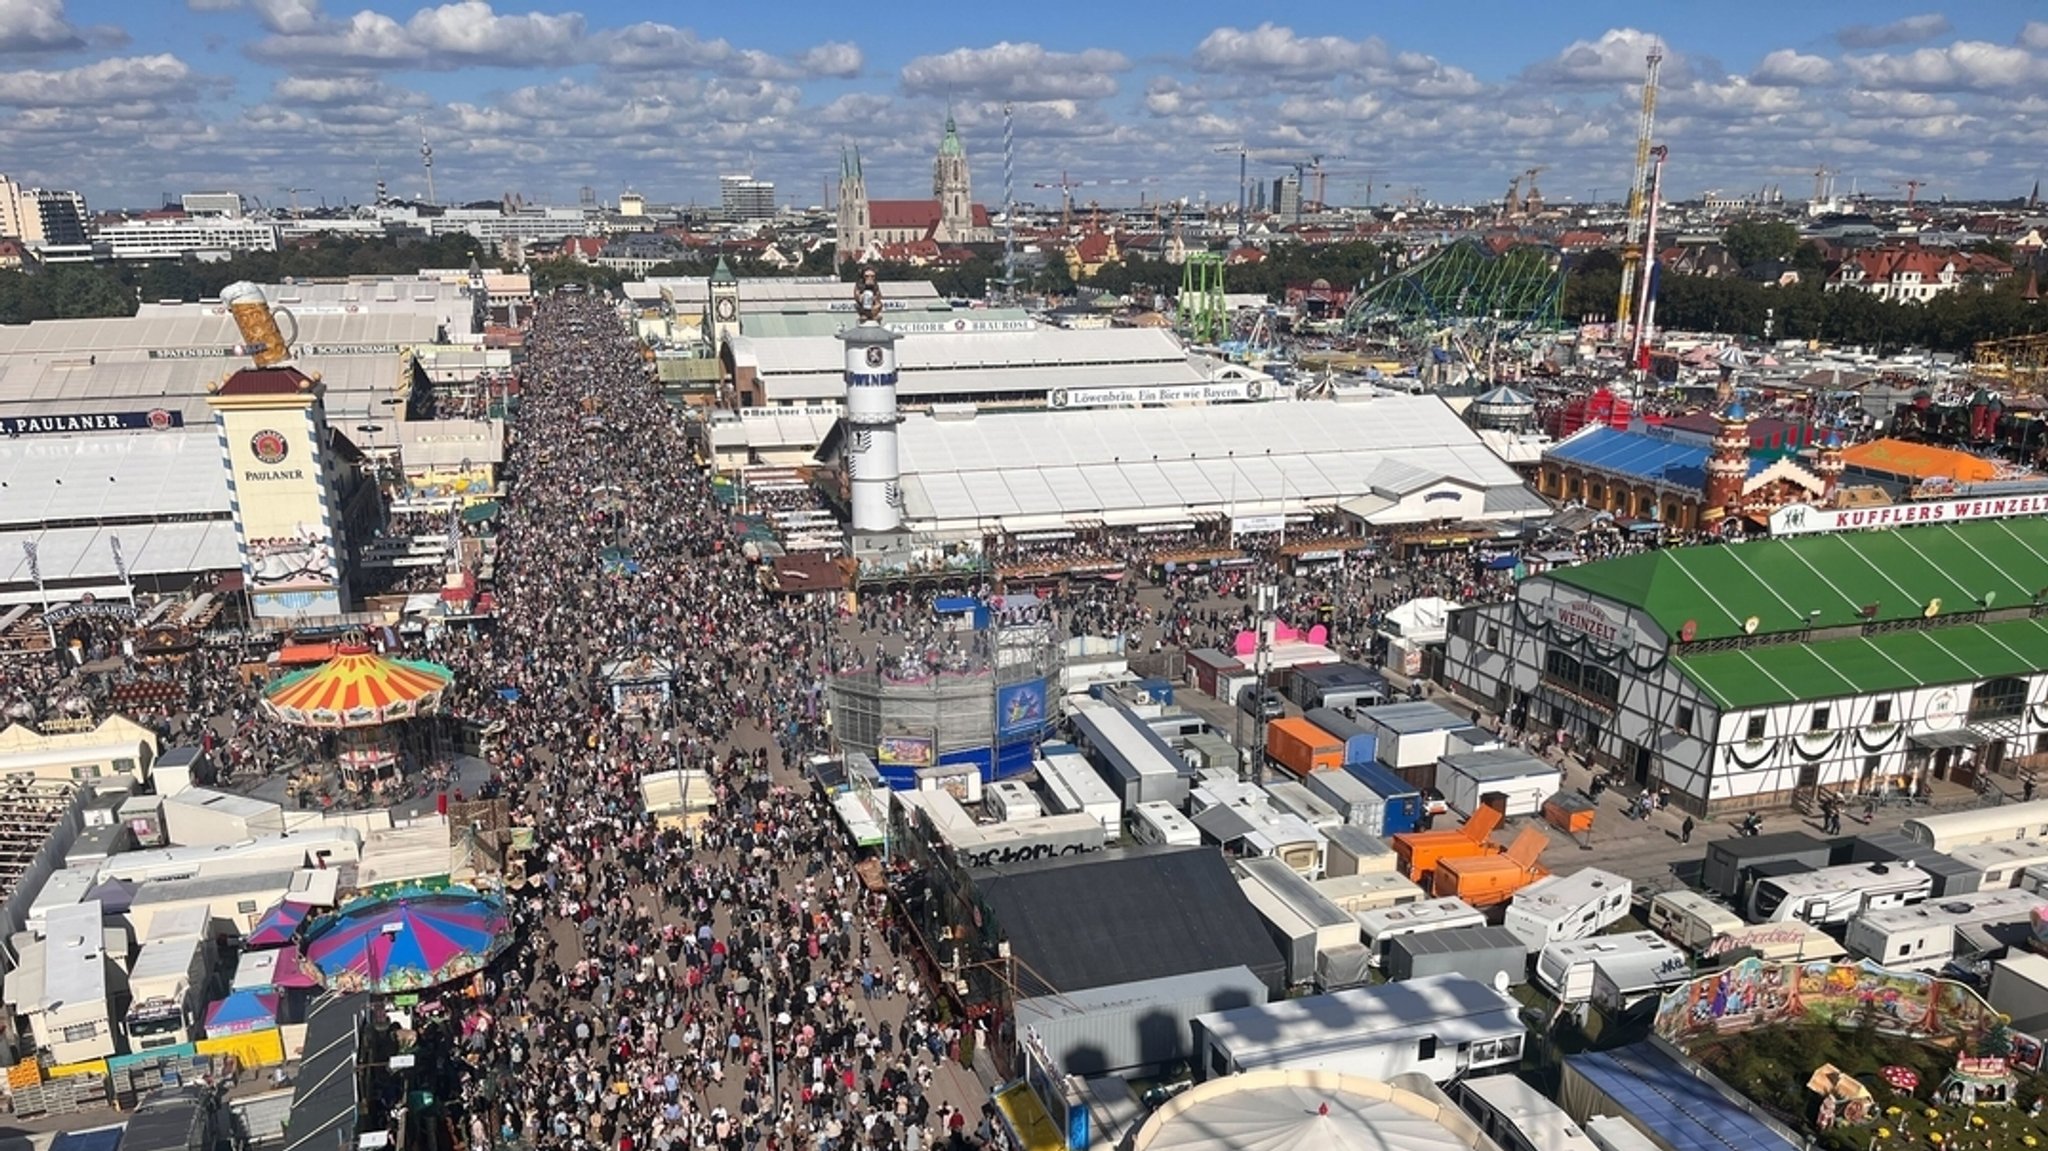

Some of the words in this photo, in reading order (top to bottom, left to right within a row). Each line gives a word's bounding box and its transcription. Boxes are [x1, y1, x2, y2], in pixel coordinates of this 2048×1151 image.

[1074, 392, 1135, 404] Löwenbräu.
[1138, 390, 1156, 401] Ein
[1159, 389, 1181, 399] Bier
[1182, 389, 1201, 399] wie
[16, 415, 128, 432] PAULANER.
[244, 469, 305, 481] PAULANER
[1836, 505, 1944, 527] KUFFLERS
[1558, 608, 1617, 641] WEINZELT
